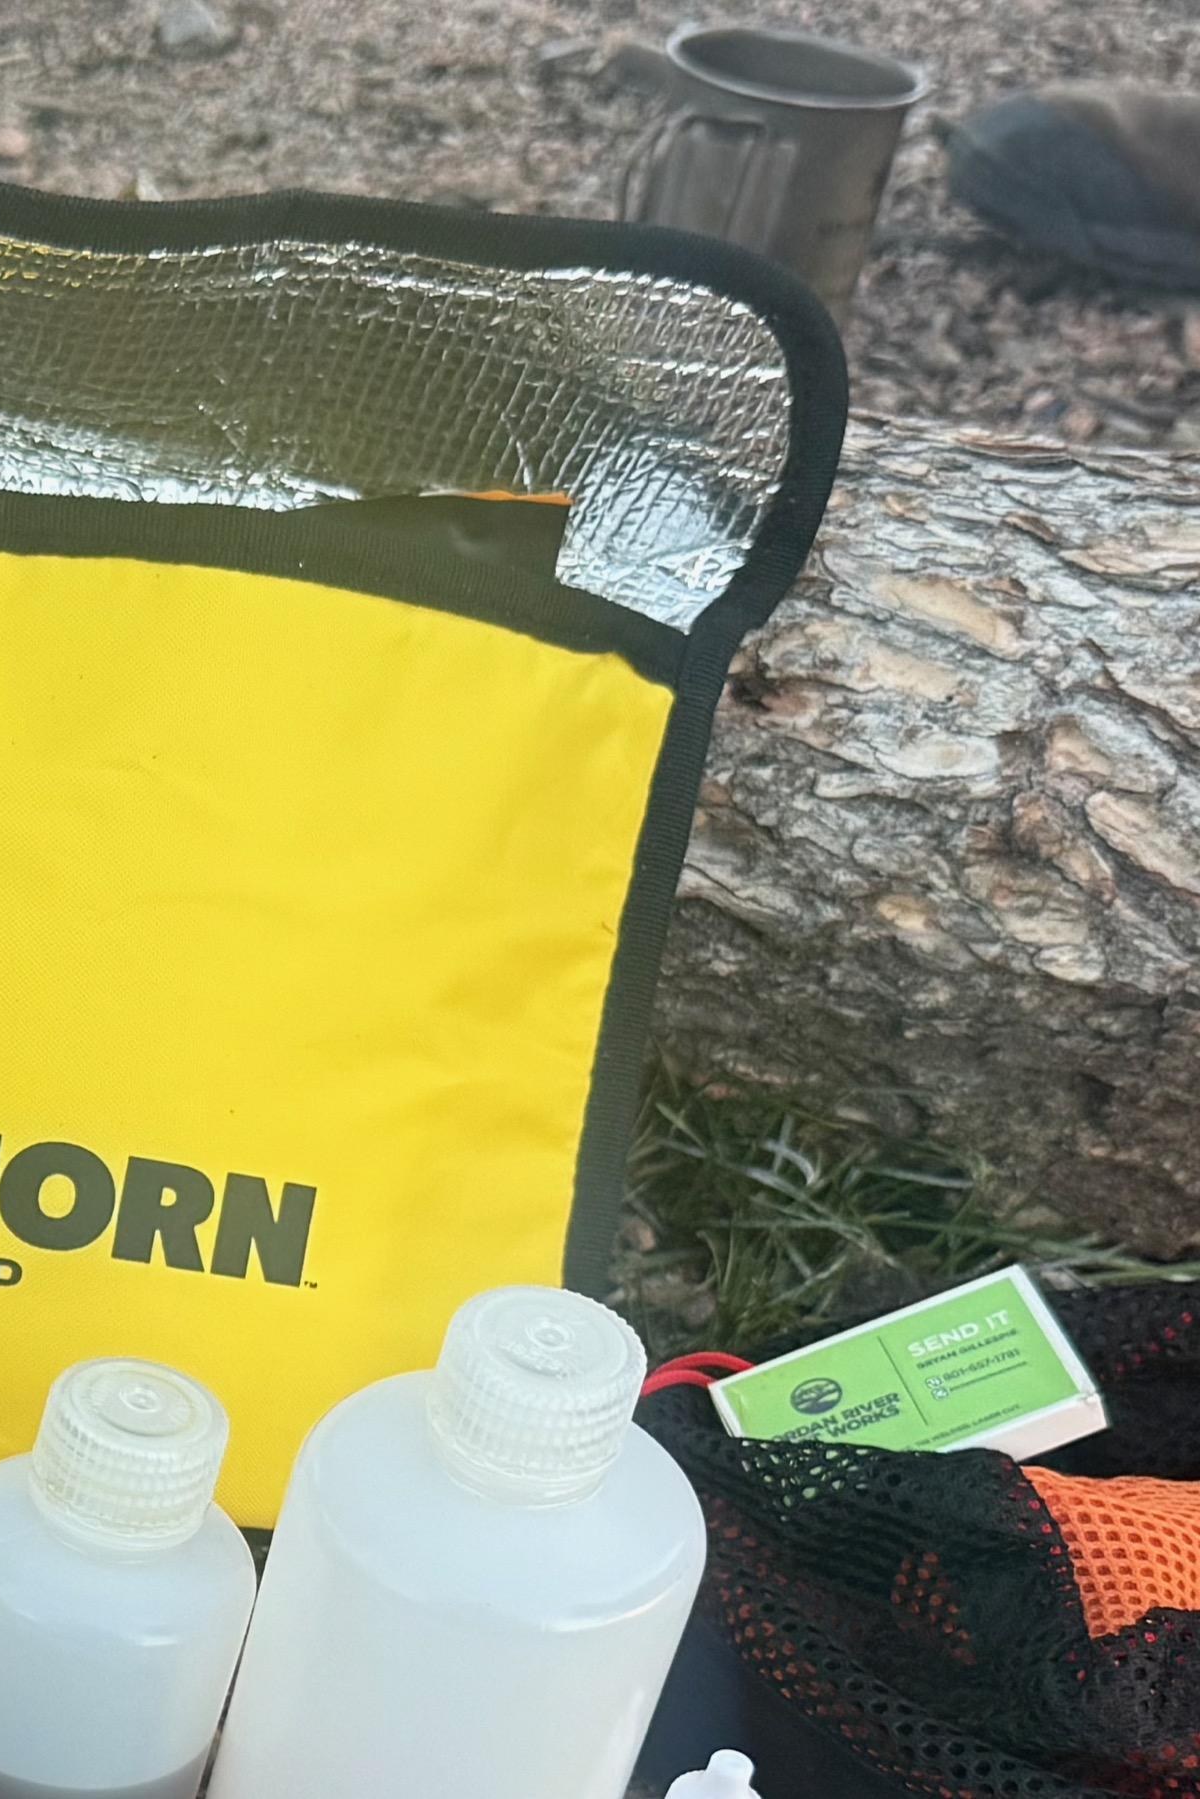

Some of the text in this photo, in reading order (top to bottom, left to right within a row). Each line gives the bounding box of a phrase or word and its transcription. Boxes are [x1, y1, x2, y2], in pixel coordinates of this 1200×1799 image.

[907, 1310, 1009, 1357] SEND IT
[772, 1415, 839, 1443] ORDAN
[841, 1392, 900, 1420] RIVER
[827, 1404, 900, 1438] WORKS
